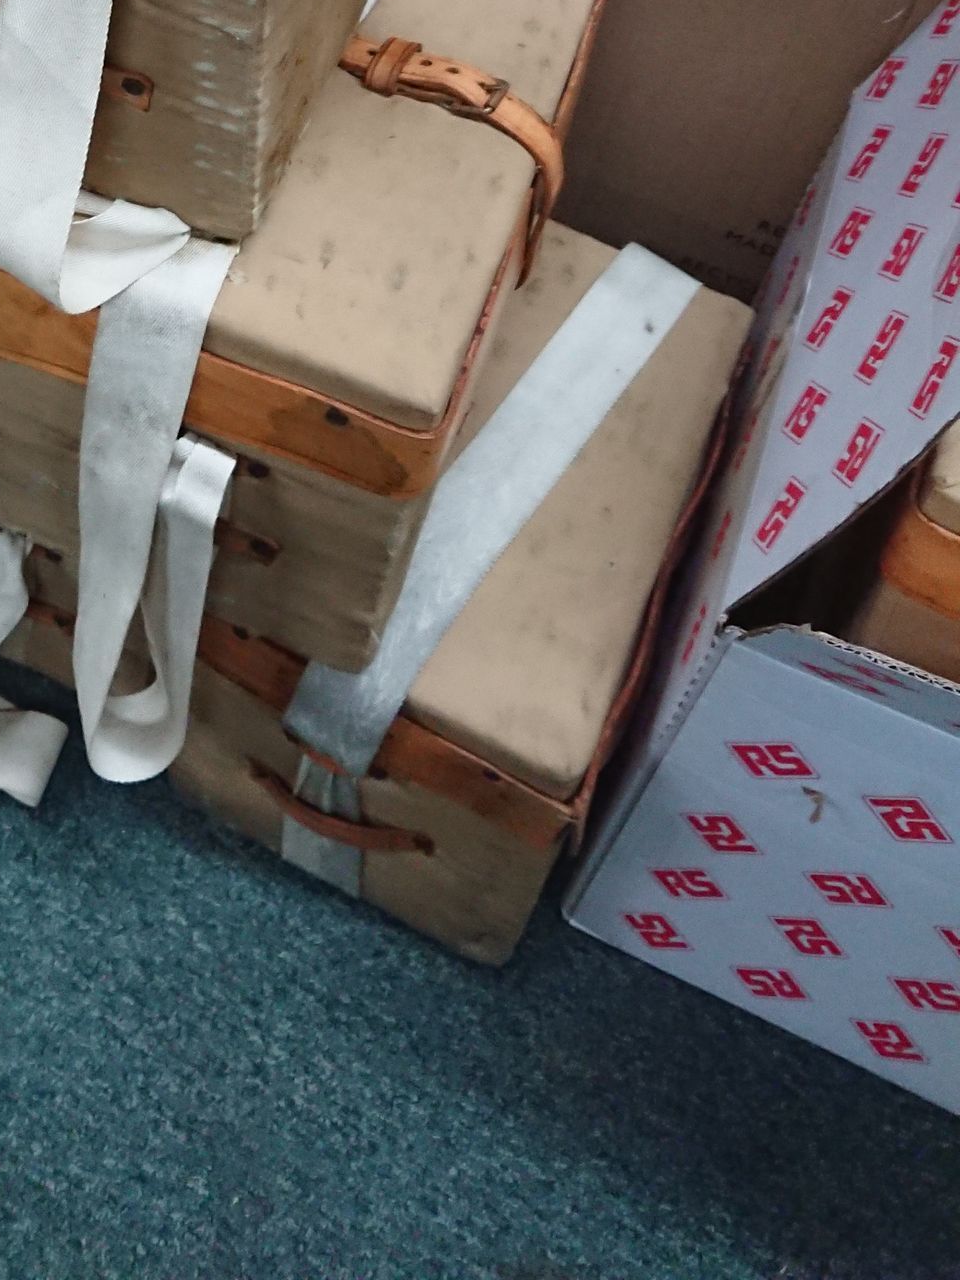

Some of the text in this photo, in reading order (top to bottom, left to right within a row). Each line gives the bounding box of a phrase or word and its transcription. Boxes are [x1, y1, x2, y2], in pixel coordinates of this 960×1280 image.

[917, 61, 958, 107] RS
[847, 125, 892, 180] RS
[899, 134, 946, 195] RS
[831, 208, 873, 257] RS
[881, 225, 923, 279] RS
[805, 288, 853, 349] RS
[855, 313, 907, 383] RS
[910, 337, 959, 417] RS
[783, 384, 829, 442] RS
[834, 420, 883, 486] RS
[754, 478, 806, 551] RS
[730, 743, 815, 778] RS
[686, 813, 758, 854] RS
[869, 797, 948, 842] RS
[651, 867, 724, 899] RS
[806, 872, 890, 908] RS
[621, 913, 687, 950] RS
[774, 917, 844, 958] RS
[735, 966, 808, 1001] RS
[893, 978, 960, 1014] RS
[855, 1022, 924, 1062] RS
